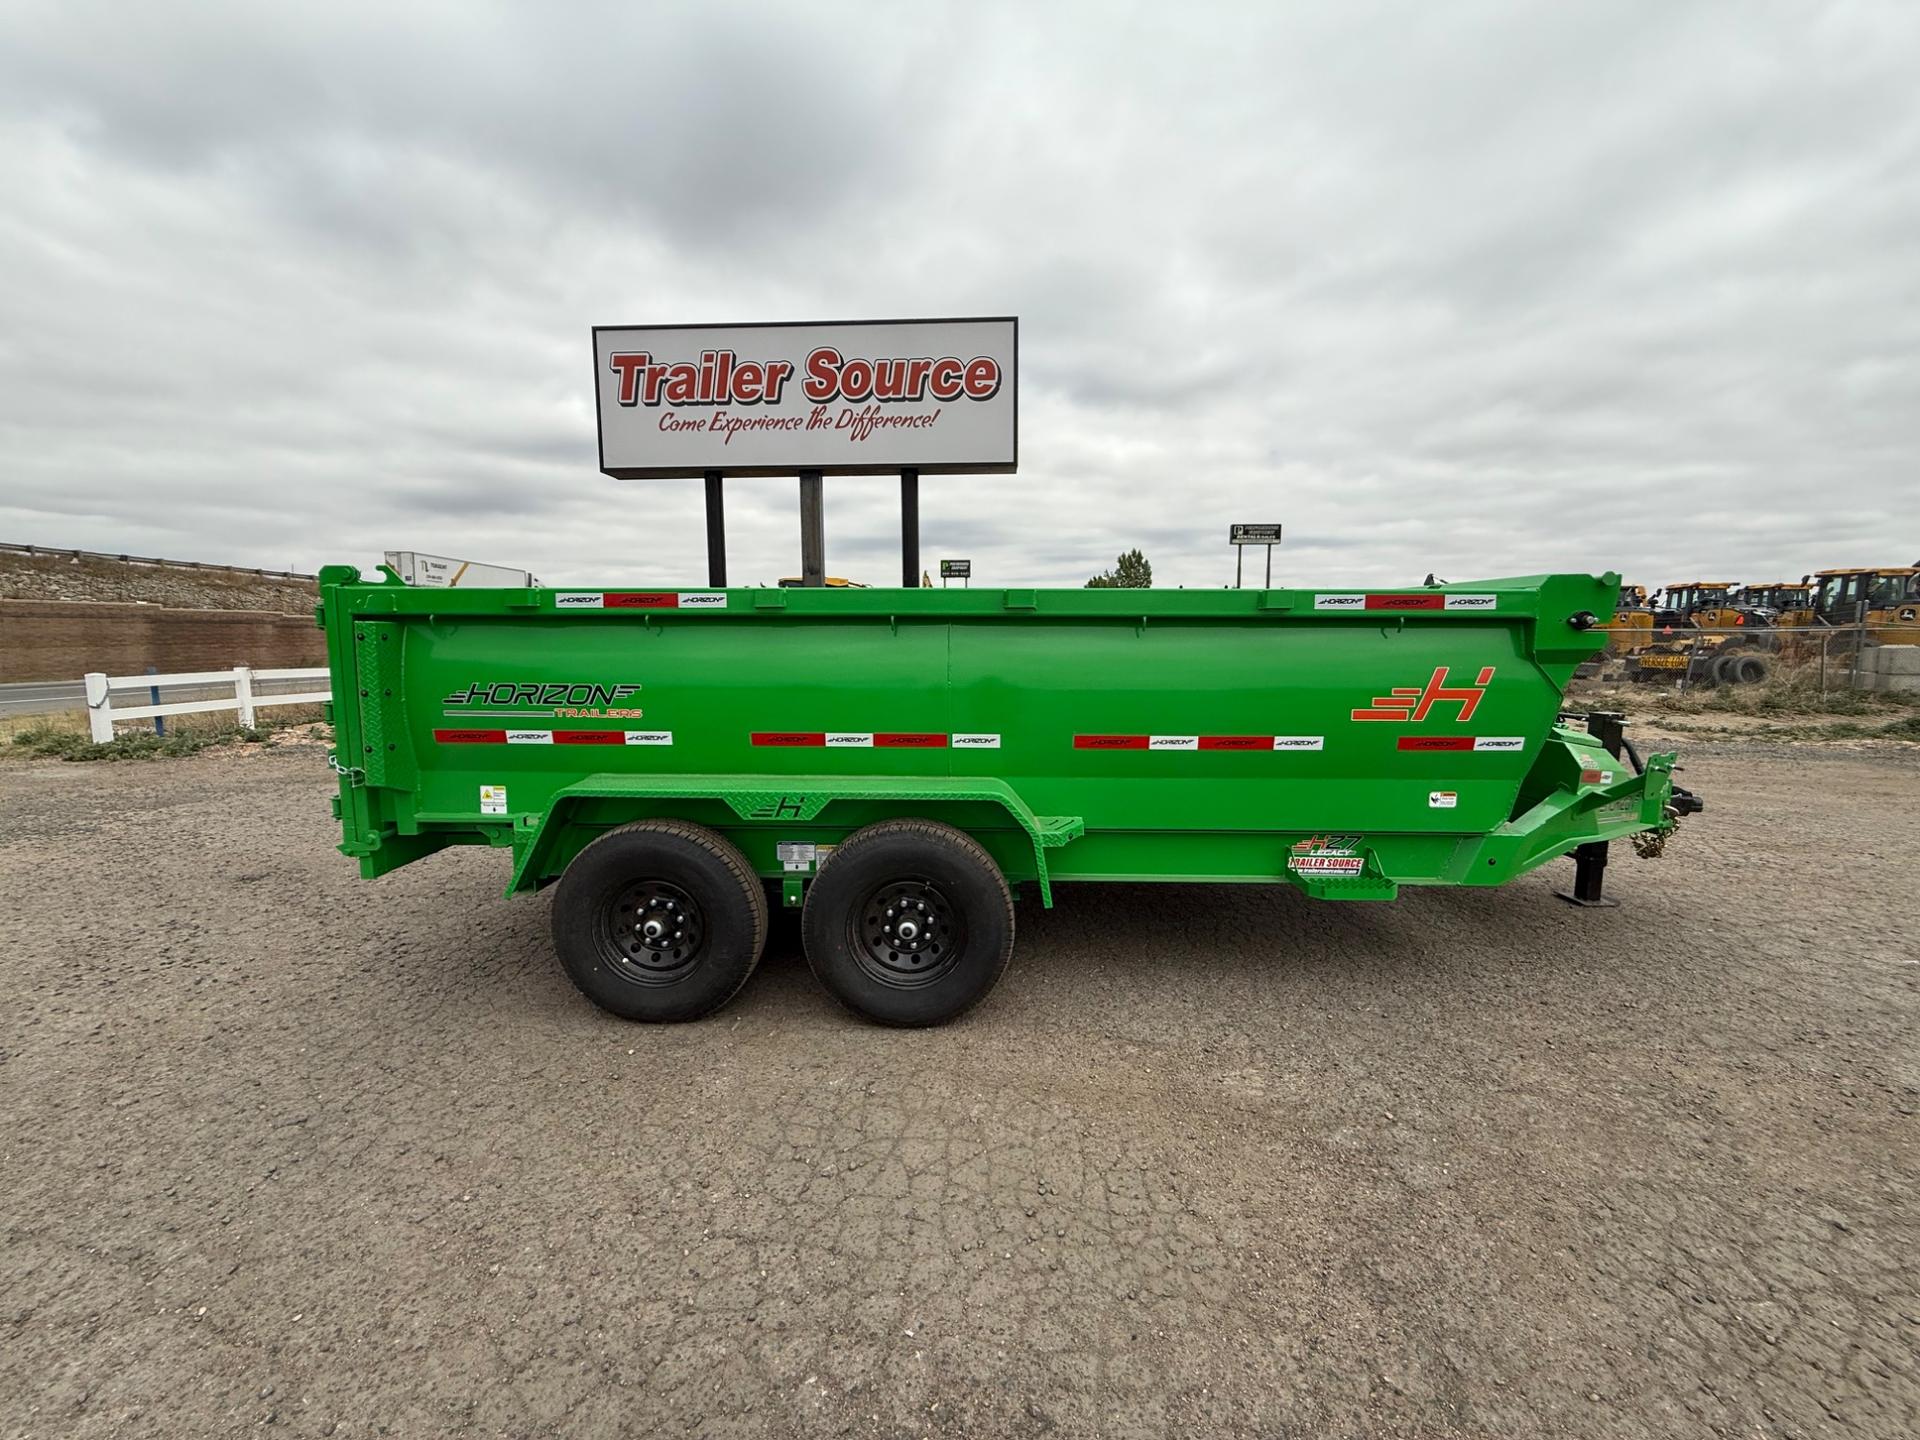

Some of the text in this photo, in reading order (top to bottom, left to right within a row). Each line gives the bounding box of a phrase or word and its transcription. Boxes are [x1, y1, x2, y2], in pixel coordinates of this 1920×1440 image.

[610, 346, 1001, 407] Trailer Source
[659, 405, 941, 445] Come Experience the Difference!
[463, 683, 622, 706] HORIZON
[554, 708, 643, 719] TRAILERS
[1327, 858, 1362, 868] SOURCE
